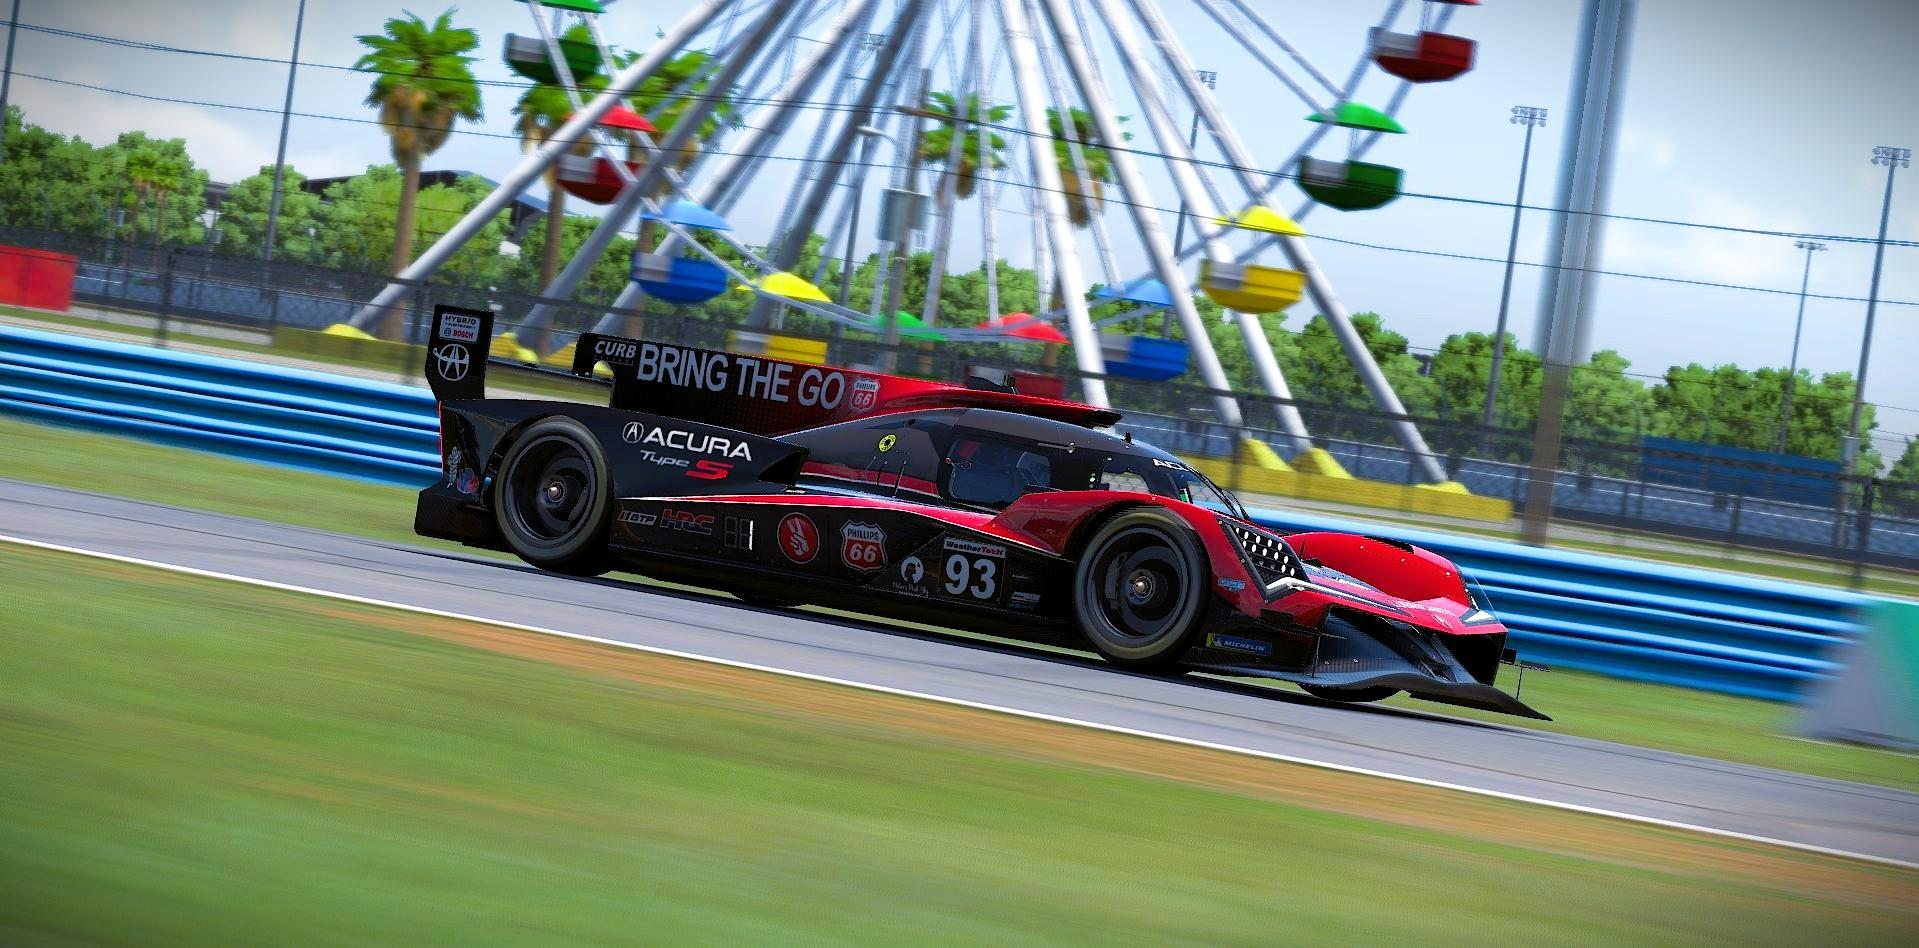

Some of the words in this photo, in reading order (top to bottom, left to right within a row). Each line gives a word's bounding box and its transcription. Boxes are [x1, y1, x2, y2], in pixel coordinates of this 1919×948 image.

[445, 315, 477, 325] HYBRID
[453, 329, 474, 339] BOSCH
[594, 340, 637, 359] CURB
[637, 343, 729, 392] BRING
[736, 357, 793, 403] THE
[797, 368, 846, 410] GO
[855, 381, 877, 391] PHILLIPS
[854, 392, 873, 406] 66
[642, 426, 752, 461] ACURA
[685, 459, 734, 480] S
[631, 513, 655, 525] GTP
[660, 508, 714, 535] HRC
[847, 528, 879, 540] PHILLIPS
[849, 543, 878, 563] 66
[946, 540, 1004, 556] WeatherTech
[944, 553, 996, 600] 93
[1224, 640, 1266, 652] MICHELIN
